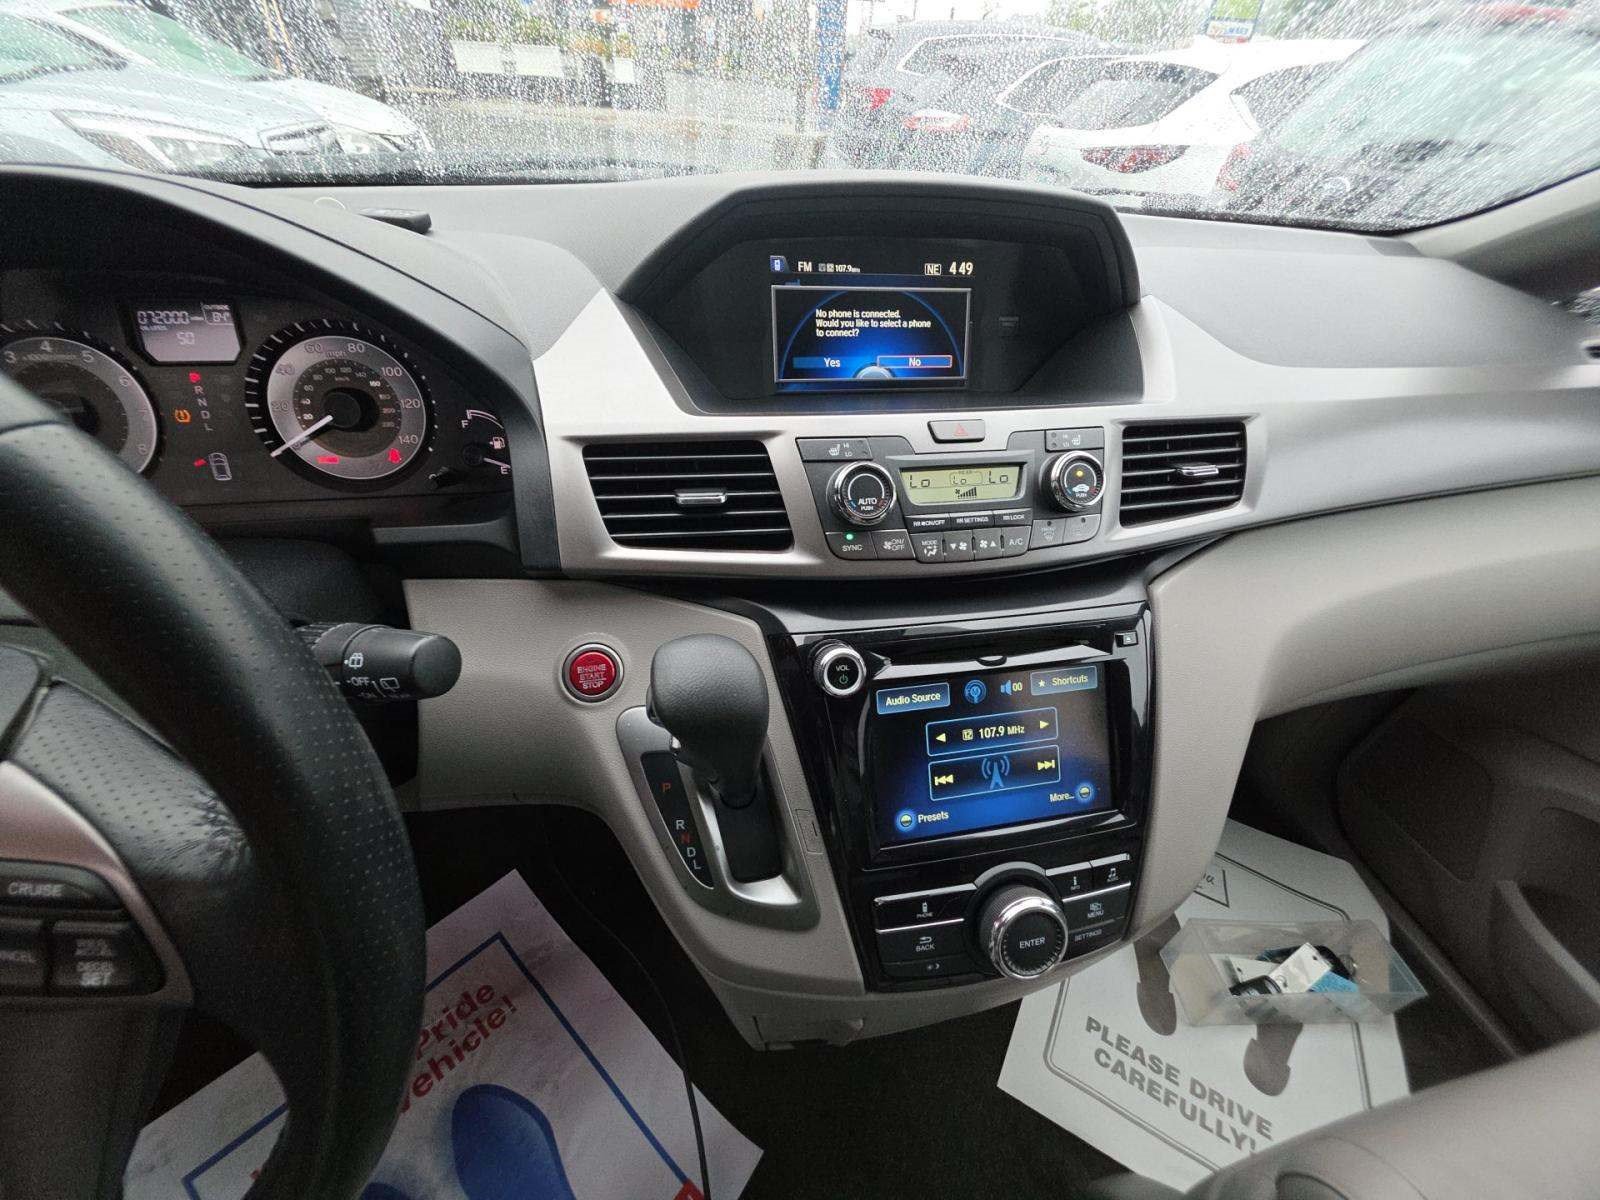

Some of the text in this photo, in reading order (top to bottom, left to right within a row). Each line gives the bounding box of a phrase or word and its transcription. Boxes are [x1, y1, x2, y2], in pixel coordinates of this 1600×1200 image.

[798, 261, 812, 272] FM
[927, 264, 940, 275] NE
[816, 308, 901, 321] No phone is connected.
[816, 318, 931, 332] Would you like to select a phone
[816, 328, 860, 338] to connect?
[347, 343, 365, 353] 80
[4, 350, 17, 364] 3
[908, 357, 921, 368] No
[824, 358, 841, 369] Yes
[381, 366, 403, 378] 100
[194, 386, 204, 394] R
[400, 398, 421, 410] 120
[200, 410, 210, 420] D
[461, 419, 469, 429] F
[399, 434, 419, 446] 140
[500, 466, 509, 475] E
[910, 474, 930, 490] Lo
[988, 470, 1009, 485] Lo
[858, 497, 878, 506] AUTO
[1010, 514, 1025, 522] LOCK
[1009, 538, 1024, 548] A/C
[842, 545, 864, 554] SYNC
[836, 664, 850, 672] VOL
[350, 676, 370, 687] OFF
[582, 680, 604, 690] STOP
[1051, 673, 1089, 687] Shortcuts
[1012, 681, 1023, 693] 00
[885, 691, 941, 707] Audio Source
[979, 726, 1005, 740] 107.9
[1007, 724, 1026, 736] MHz
[662, 782, 671, 793] P
[917, 811, 949, 825] Presets
[676, 820, 685, 831] R
[686, 847, 696, 858] D
[694, 860, 702, 870] L
[8, 882, 61, 898] CRUISE
[1087, 910, 1104, 920] MENU
[1019, 936, 1046, 949] ENTER
[916, 944, 936, 954] BACK
[401, 995, 517, 1113] ehicle!
[1085, 1015, 1273, 1141] PLEASE DRIVE
[1093, 1047, 1256, 1154] CAREFULLY!
